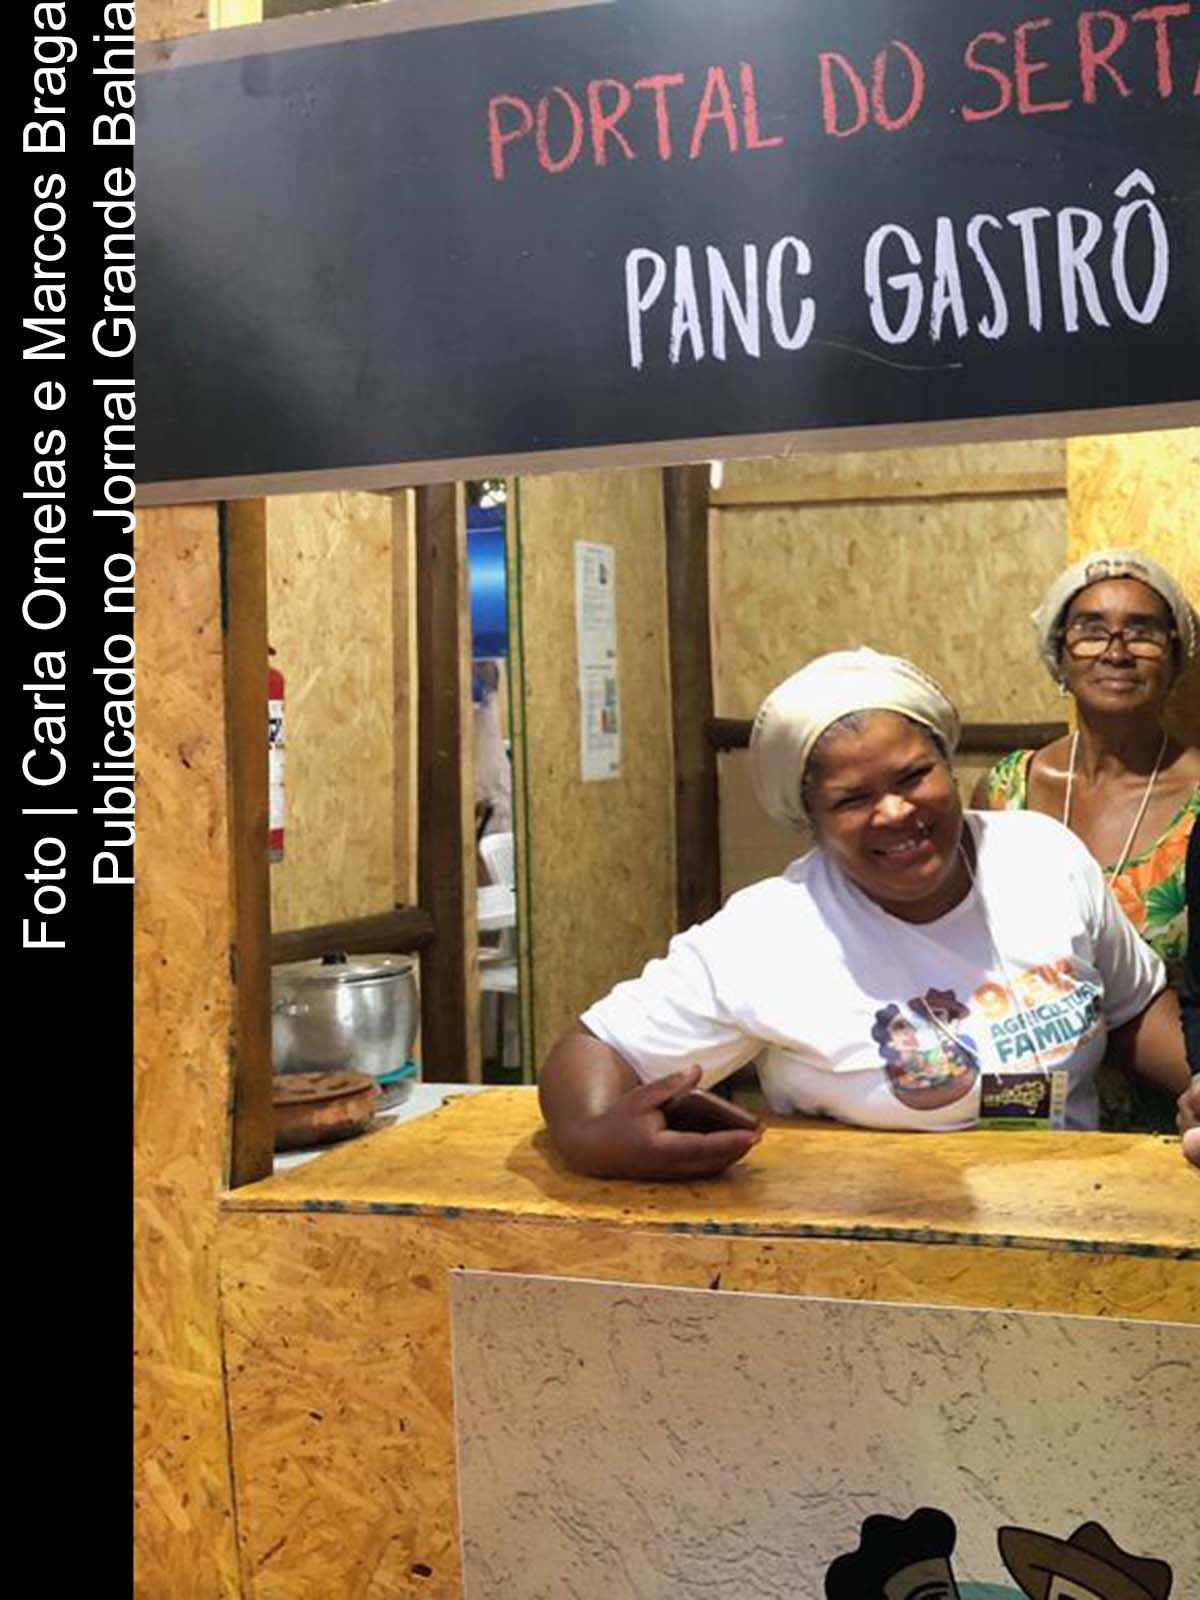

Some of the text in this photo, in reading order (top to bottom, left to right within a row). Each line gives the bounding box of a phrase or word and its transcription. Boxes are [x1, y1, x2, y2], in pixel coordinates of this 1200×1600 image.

[488, 61, 783, 180] PORTAL
[819, 41, 924, 136] DO
[625, 168, 1169, 370] PANC GASTRÔ
